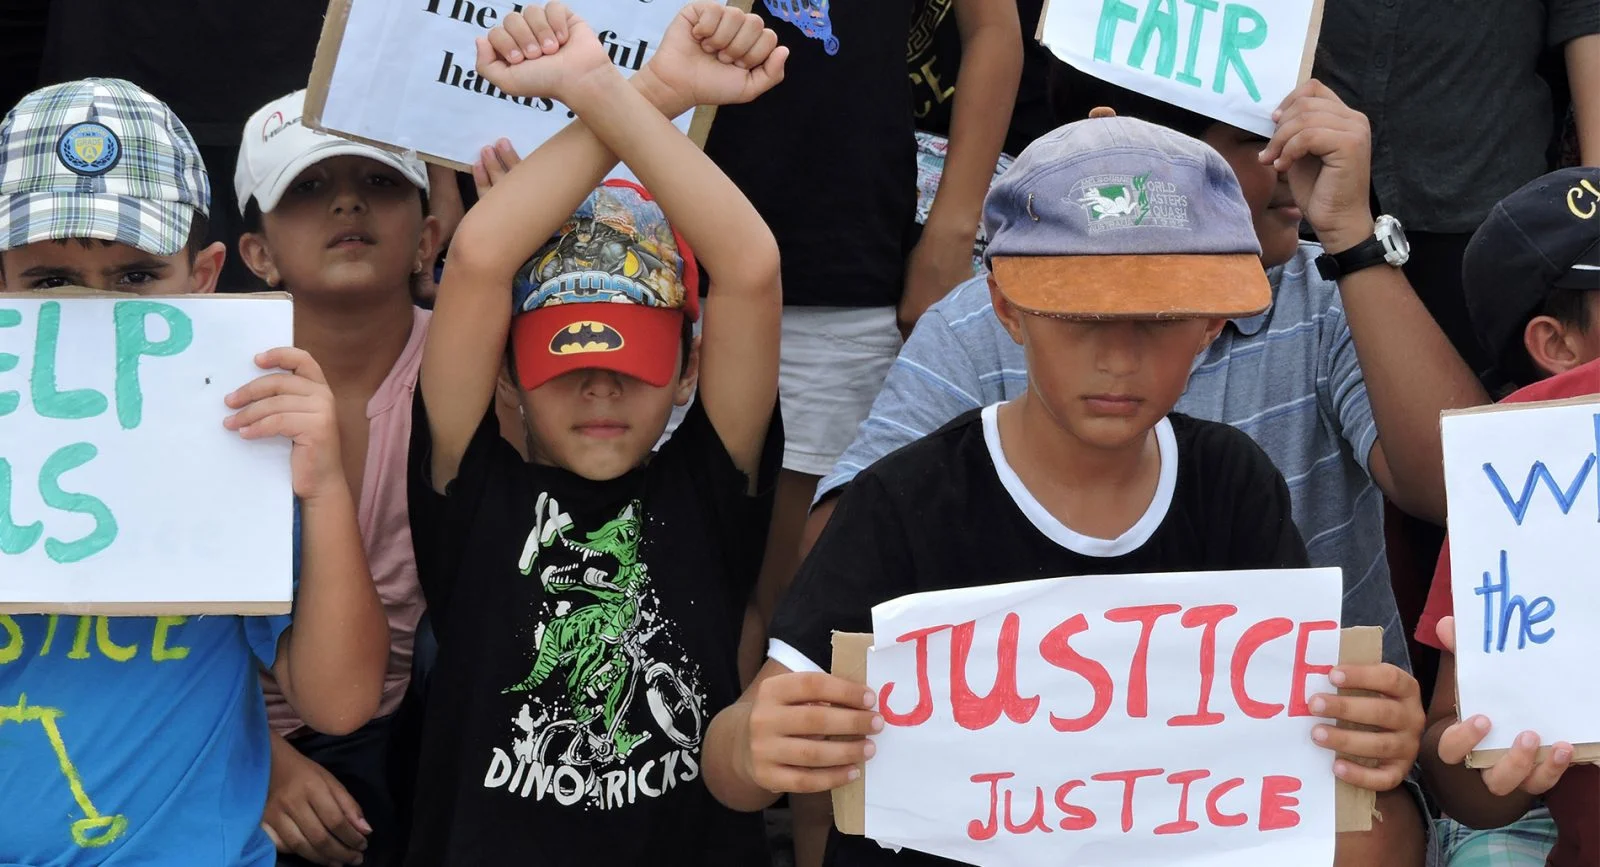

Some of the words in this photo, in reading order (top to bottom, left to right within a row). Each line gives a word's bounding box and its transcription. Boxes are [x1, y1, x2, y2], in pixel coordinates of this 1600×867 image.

[1094, 0, 1268, 103] FAIR
[1474, 550, 1556, 653] the
[878, 603, 1338, 732] JUSTICE
[484, 747, 585, 806] DINO
[967, 768, 1302, 841] JUSTICE
